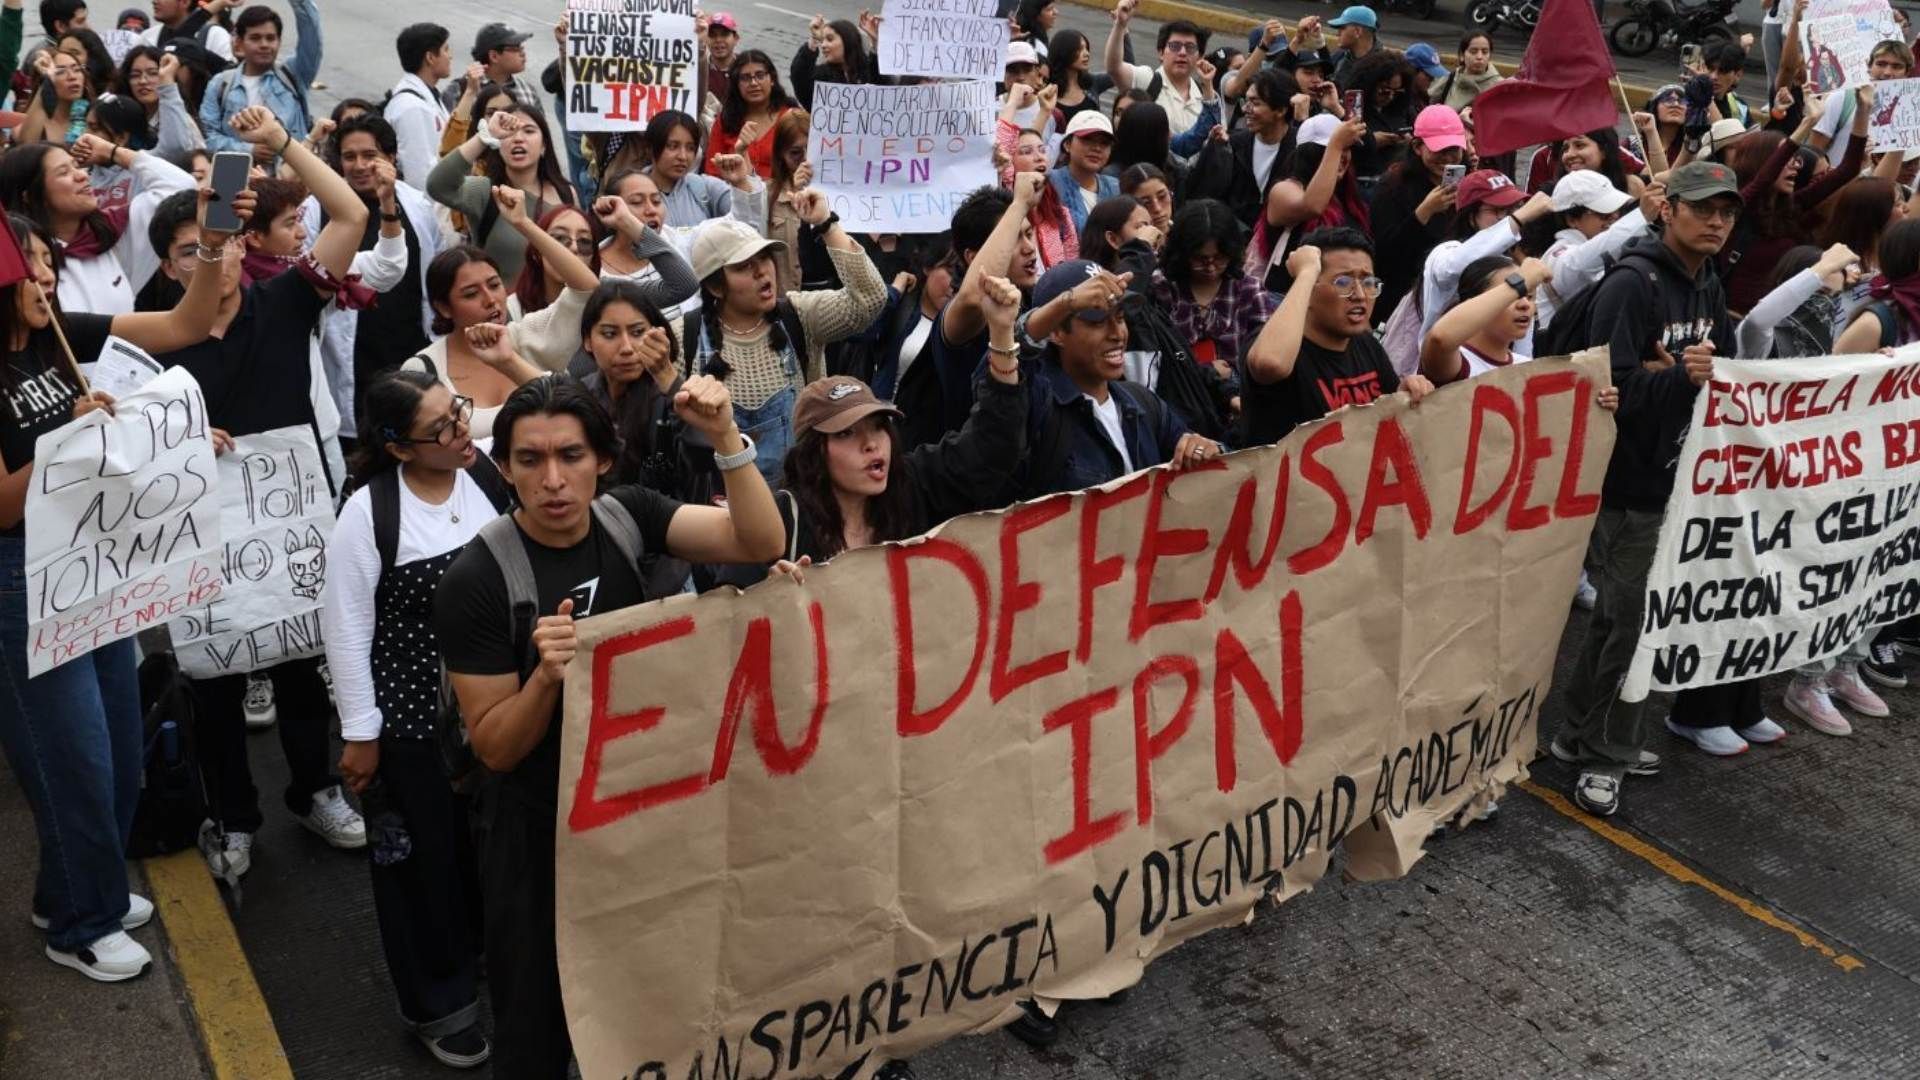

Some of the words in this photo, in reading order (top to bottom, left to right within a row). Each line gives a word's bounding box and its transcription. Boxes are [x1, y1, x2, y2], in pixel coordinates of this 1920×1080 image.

[570, 12, 653, 37] LLENASTE
[894, 16, 1003, 46] TRANSCURSO
[569, 36, 607, 56] TUS
[893, 42, 914, 72] DE
[920, 44, 943, 71] LA
[568, 57, 687, 87] VACIASTE
[570, 84, 598, 113] AL
[815, 84, 850, 110] NOS
[854, 86, 942, 111] QUITARON
[812, 107, 850, 134] QUE
[856, 109, 894, 137] NOS
[896, 110, 976, 137] QUITARON
[820, 136, 966, 157] MIEDO
[820, 159, 853, 184] EL
[864, 157, 930, 185] IPN
[858, 195, 883, 222] SE
[1316, 370, 1381, 412] VANS
[1703, 374, 1860, 428] ESCUELA
[1692, 430, 1863, 496] CIENCIAS
[70, 454, 208, 548] NOS
[1679, 515, 1743, 563] DE
[1751, 510, 1795, 555] LA
[1798, 555, 1865, 611] SIN
[569, 602, 828, 832] EN
[886, 417, 1430, 737] DEFENSA
[1453, 371, 1599, 535] DEL
[1651, 644, 1700, 685] NO
[1715, 631, 1799, 681] HAY
[1043, 589, 1303, 864] IPN
[1092, 868, 1129, 953] Y
[1140, 774, 1358, 937] DIGNIDAD
